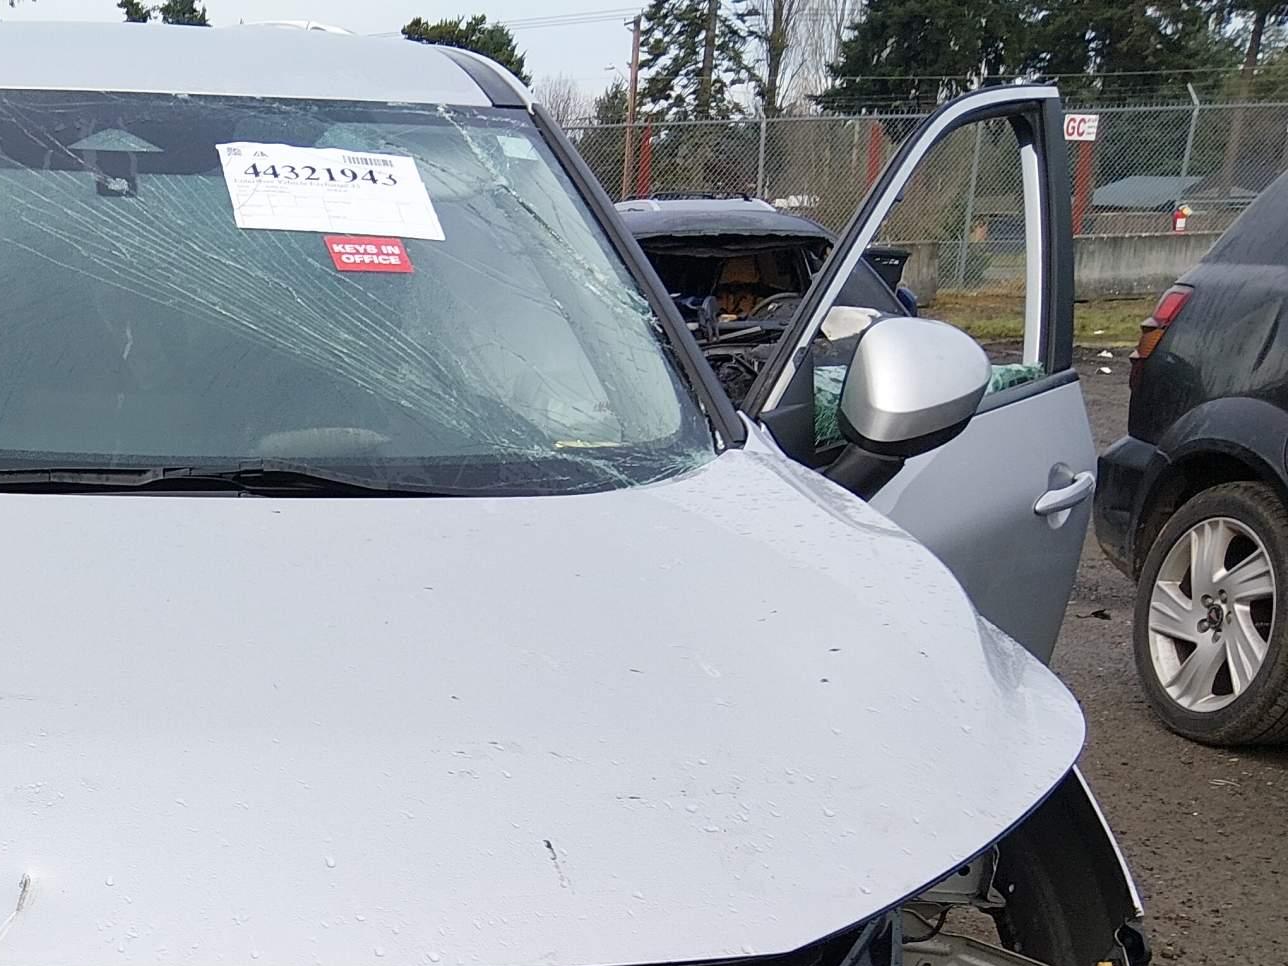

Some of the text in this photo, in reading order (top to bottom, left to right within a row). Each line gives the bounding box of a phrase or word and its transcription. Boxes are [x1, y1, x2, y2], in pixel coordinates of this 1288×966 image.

[1066, 118, 1087, 137] GC
[332, 243, 401, 255] KEYS IN
[341, 254, 401, 265] OFFICE
